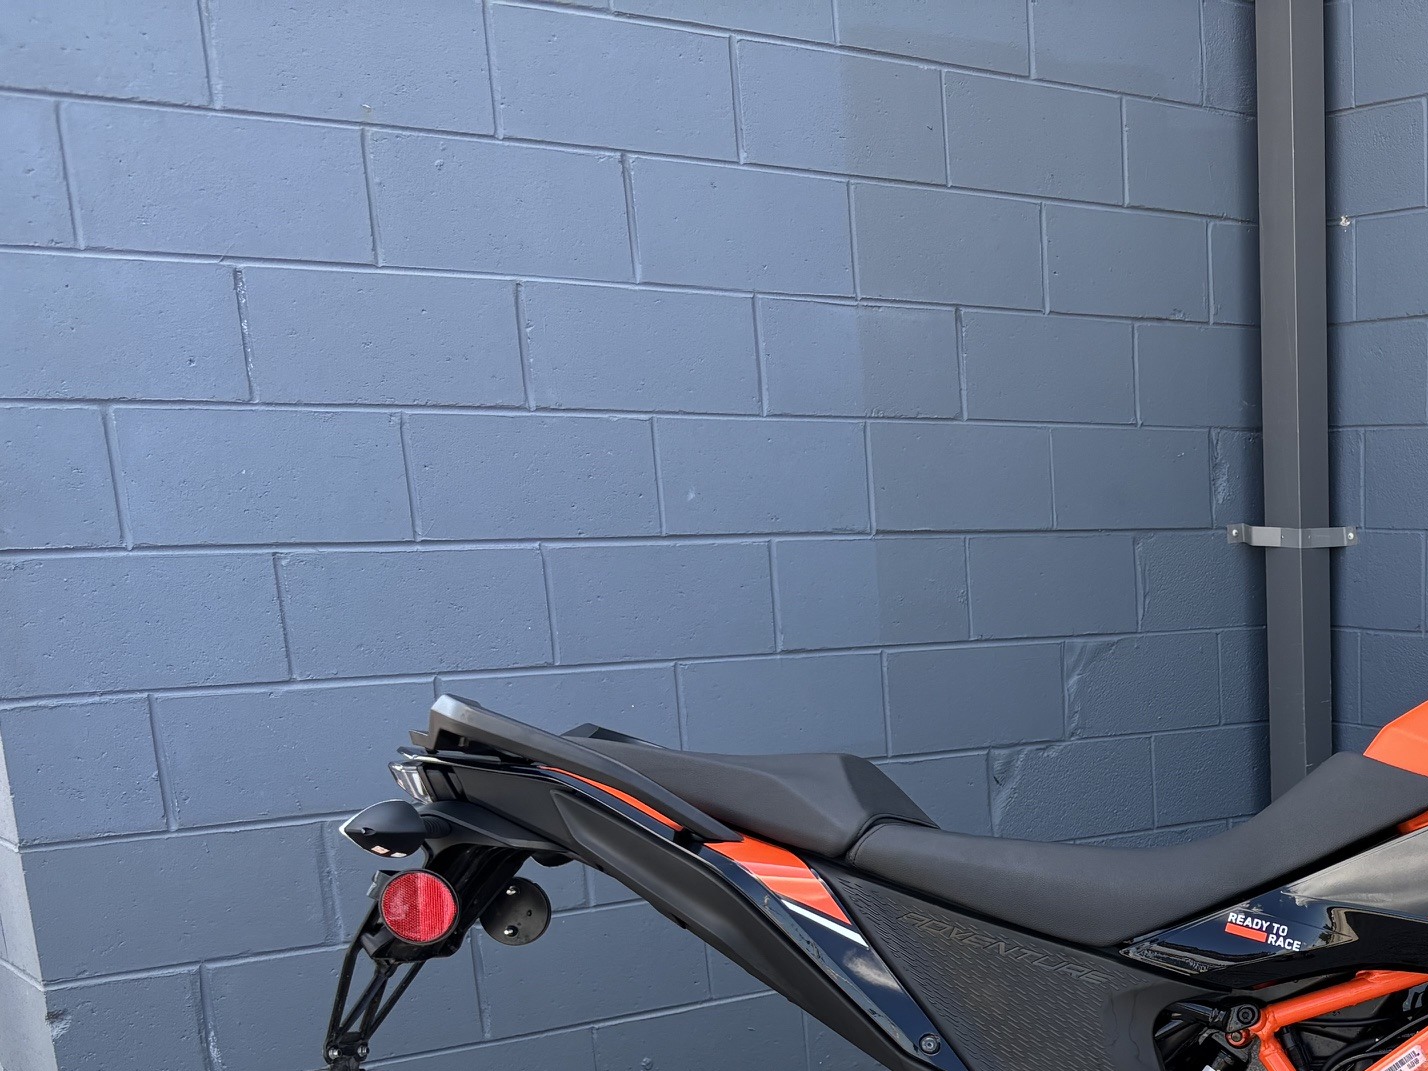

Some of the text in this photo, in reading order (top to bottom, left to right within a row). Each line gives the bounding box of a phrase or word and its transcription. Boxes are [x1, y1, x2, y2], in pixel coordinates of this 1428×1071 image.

[1227, 912, 1288, 937] READY TO
[898, 912, 1115, 984] ADVENTURE
[1267, 934, 1302, 952] RACE
